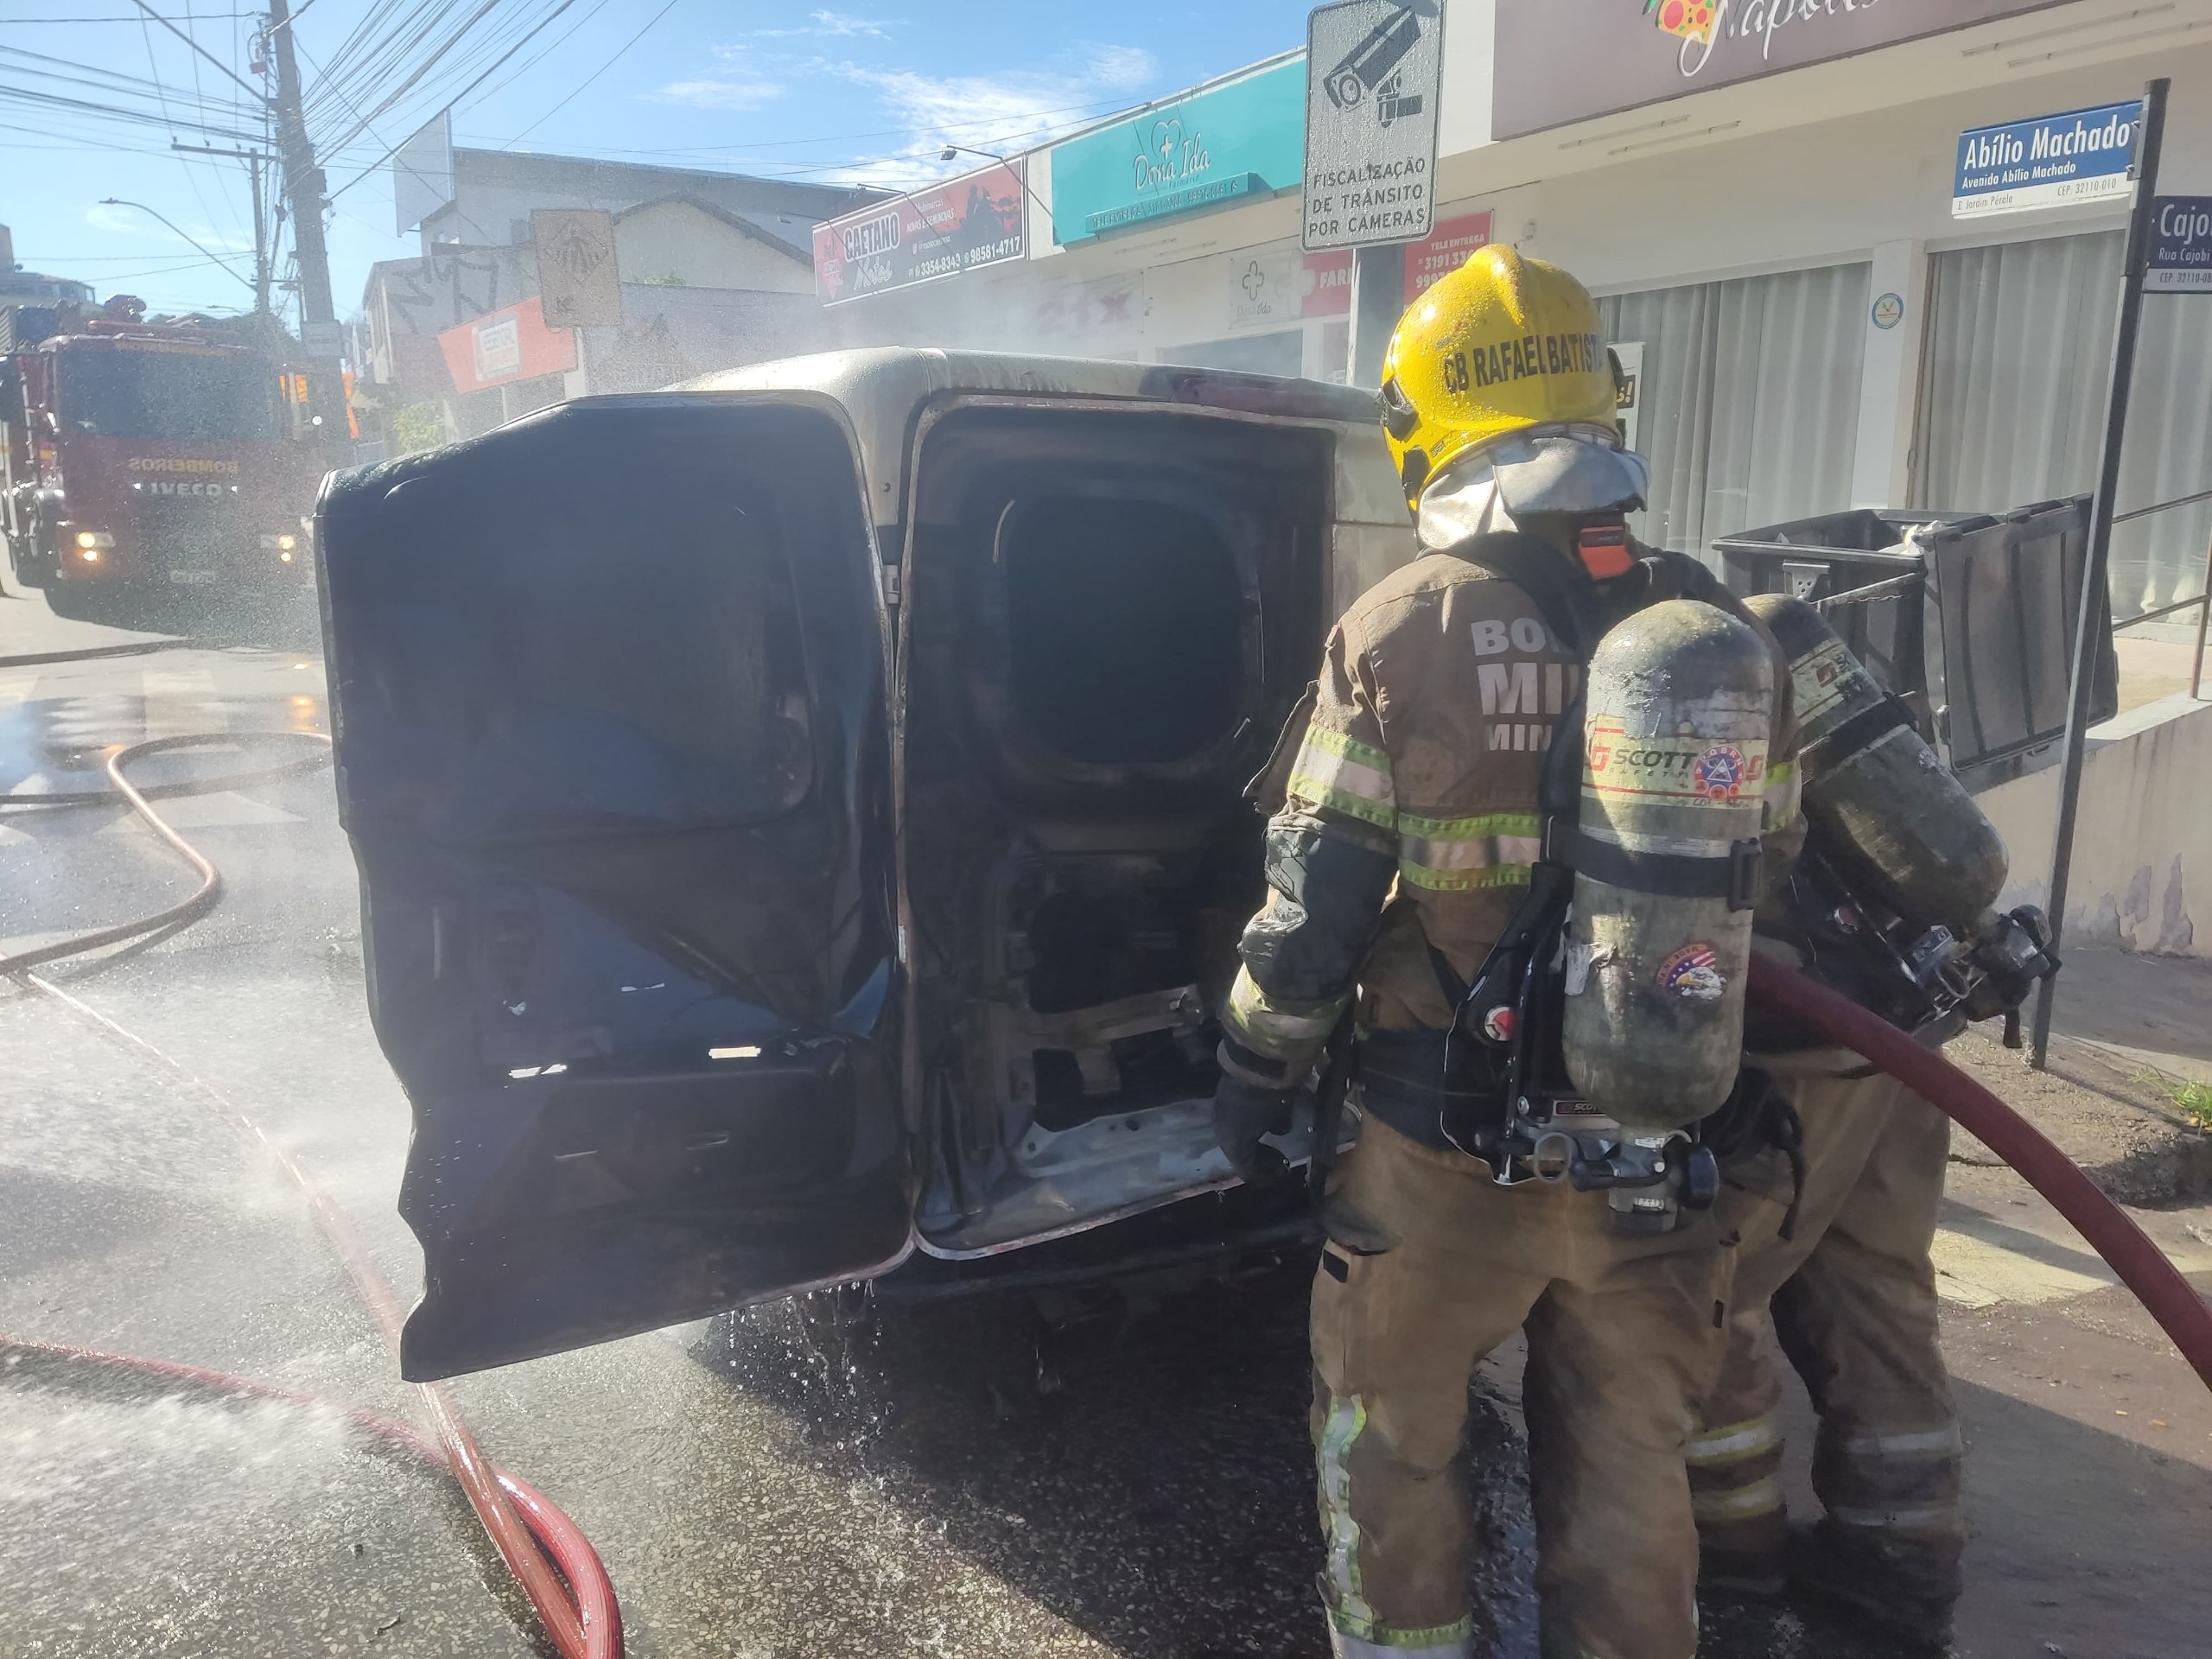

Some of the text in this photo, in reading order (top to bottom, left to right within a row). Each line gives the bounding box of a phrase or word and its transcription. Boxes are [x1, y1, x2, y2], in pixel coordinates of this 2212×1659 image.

[1964, 115, 2130, 170] Abílio Machado
[1135, 131, 1210, 190] Dona Ida
[1313, 157, 1426, 190] FISCALIZAÇÃO
[1962, 161, 2076, 189] Avenida Abílio Machado
[2057, 178, 2116, 196] CEP: 32110-010
[1313, 196, 1333, 214] DE
[1966, 197, 1988, 210] Jardim
[1990, 194, 2013, 207] Pérola
[1309, 219, 1339, 238] POR
[2159, 204, 2212, 245] Cajo
[844, 213, 900, 262] CAETANO
[1450, 233, 1485, 249] ENTREGA
[970, 236, 1021, 264] 98581-4717
[2159, 248, 2210, 265] Rua Cajobi
[1425, 253, 1449, 270] 3191
[1445, 353, 1469, 394] CB
[1473, 335, 1547, 388] RAFAEL
[149, 482, 222, 496] IVECO
[1612, 749, 1699, 769] SCOTT
